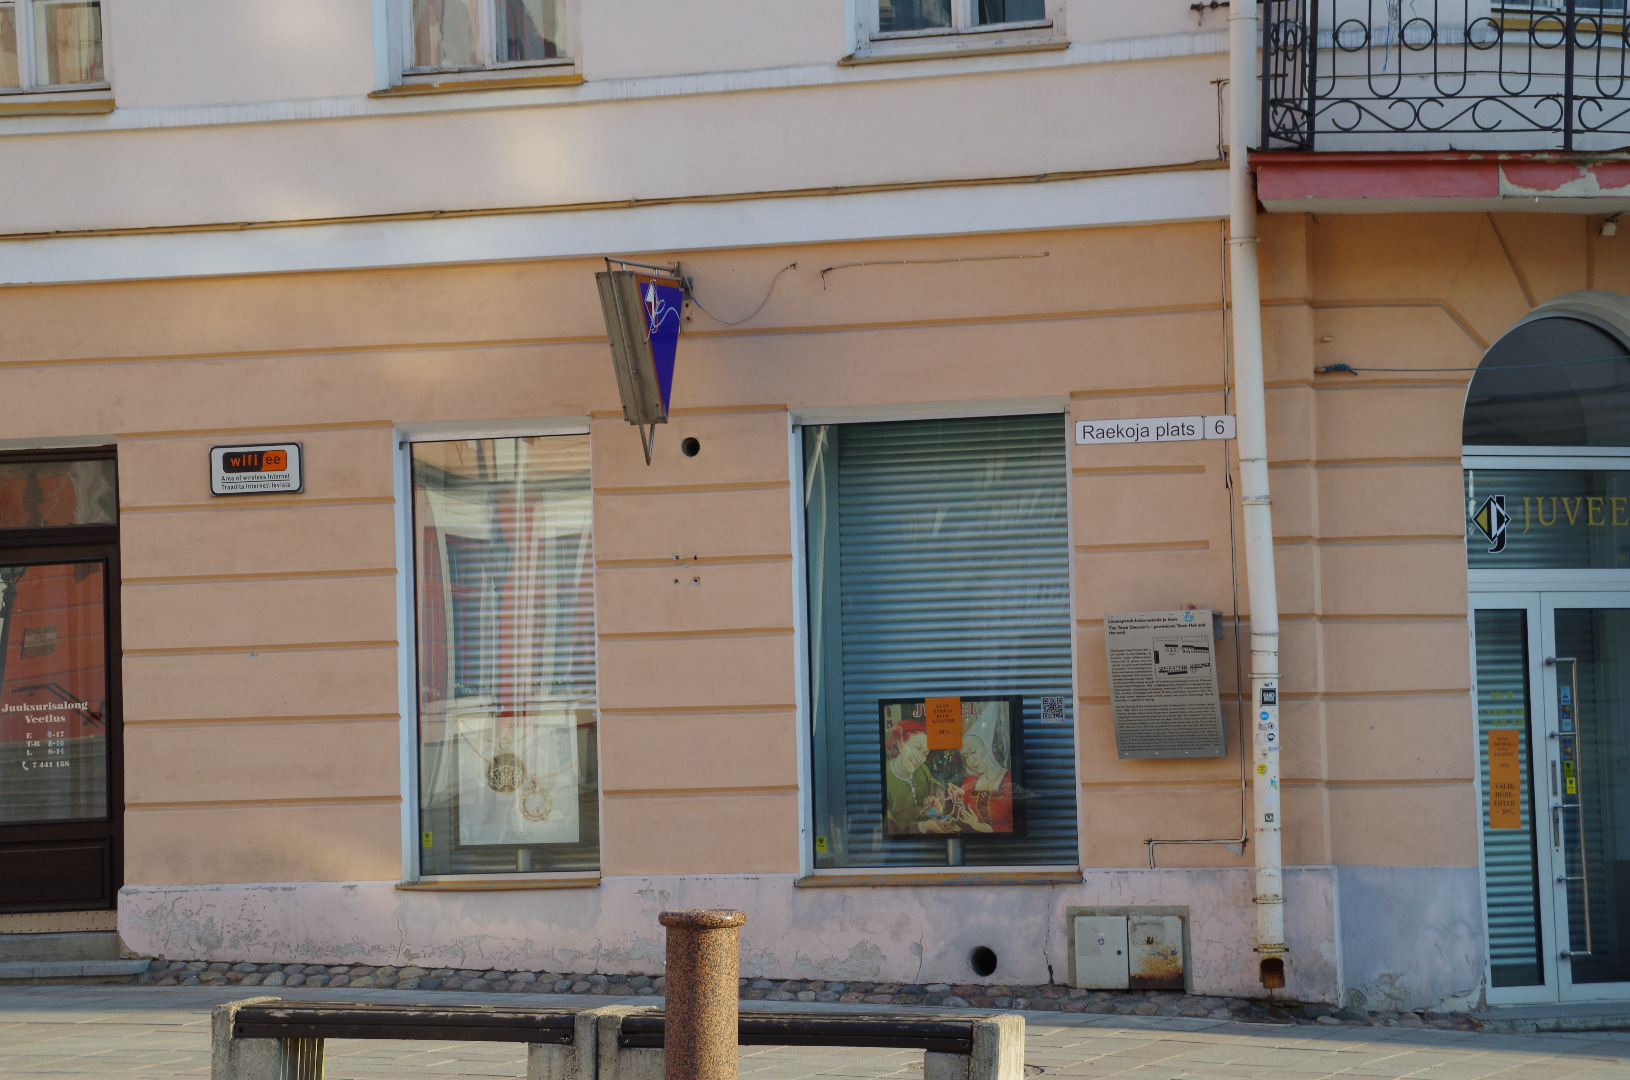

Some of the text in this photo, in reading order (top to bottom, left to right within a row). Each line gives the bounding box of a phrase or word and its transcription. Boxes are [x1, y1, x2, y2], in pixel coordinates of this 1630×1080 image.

[1082, 422, 1195, 441] Raekoja plats
[1215, 419, 1225, 434] 6
[230, 454, 281, 467] wifi ee
[1521, 496, 1630, 534] JUVEE
[1, 701, 89, 712] Juuksurisalong
[25, 714, 66, 724] Veetlus
[25, 740, 41, 748] T-R
[32, 761, 37, 769] 7
